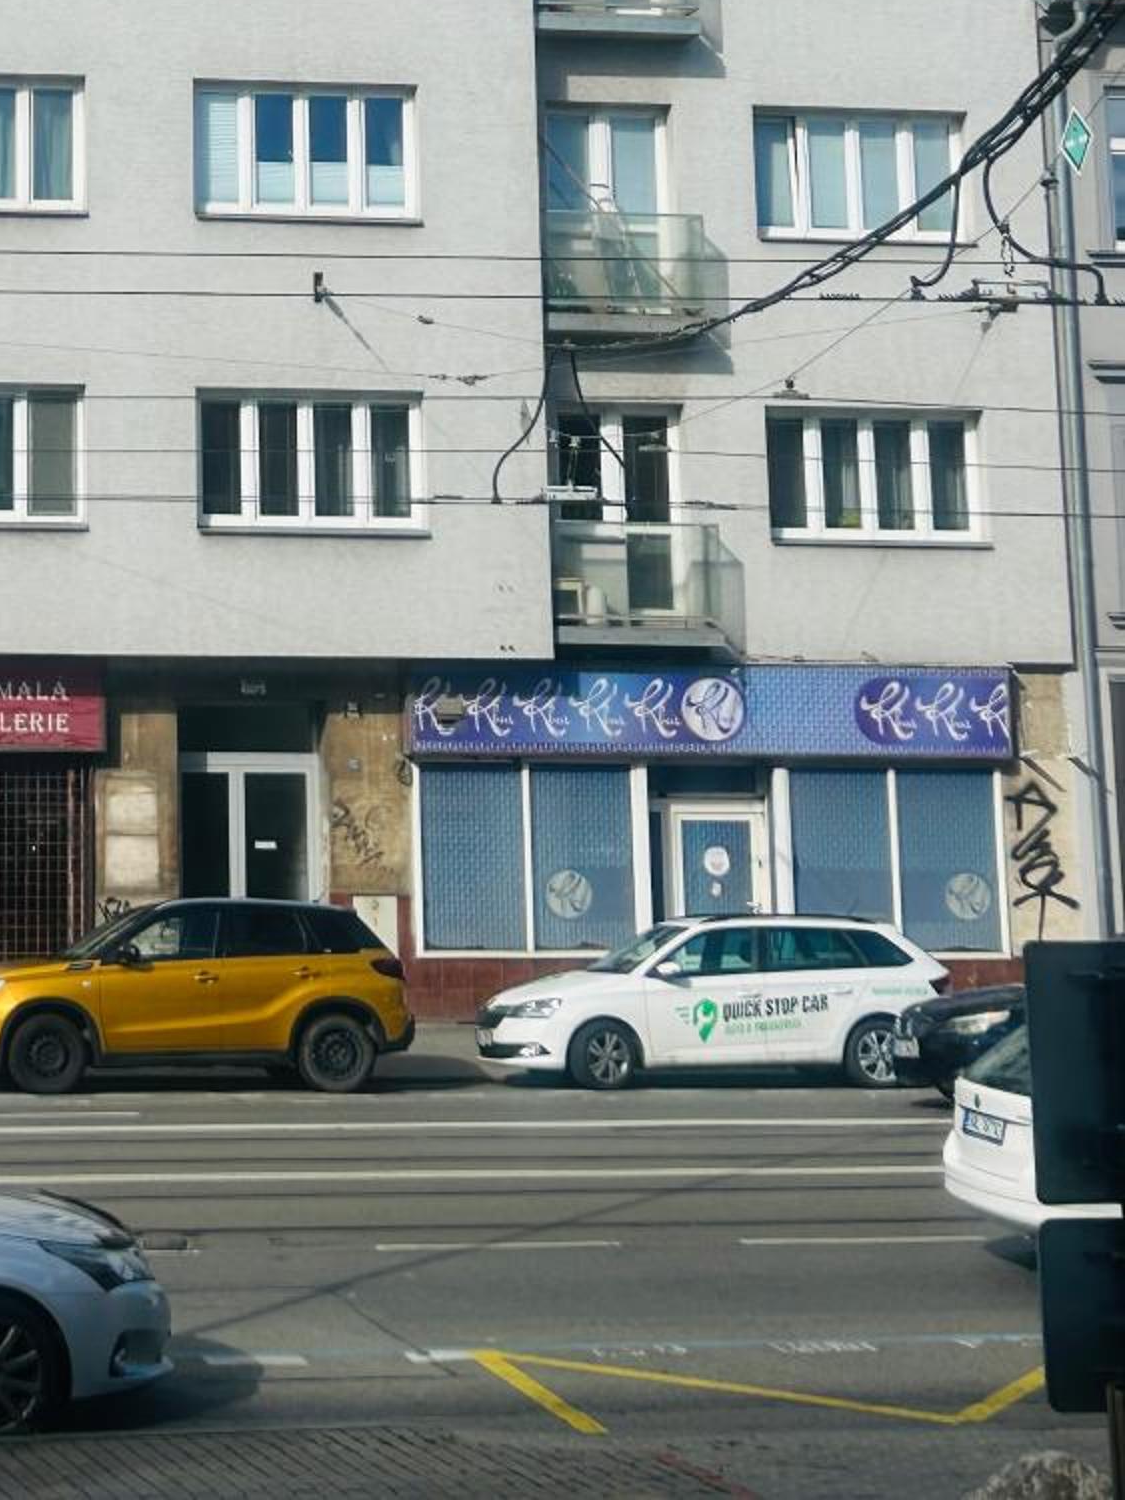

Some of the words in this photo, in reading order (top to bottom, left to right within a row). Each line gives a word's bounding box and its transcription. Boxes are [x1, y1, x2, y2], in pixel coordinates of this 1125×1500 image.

[722, 998, 763, 1023] QUICK
[764, 995, 799, 1016] STOP
[801, 993, 829, 1013] CAR
